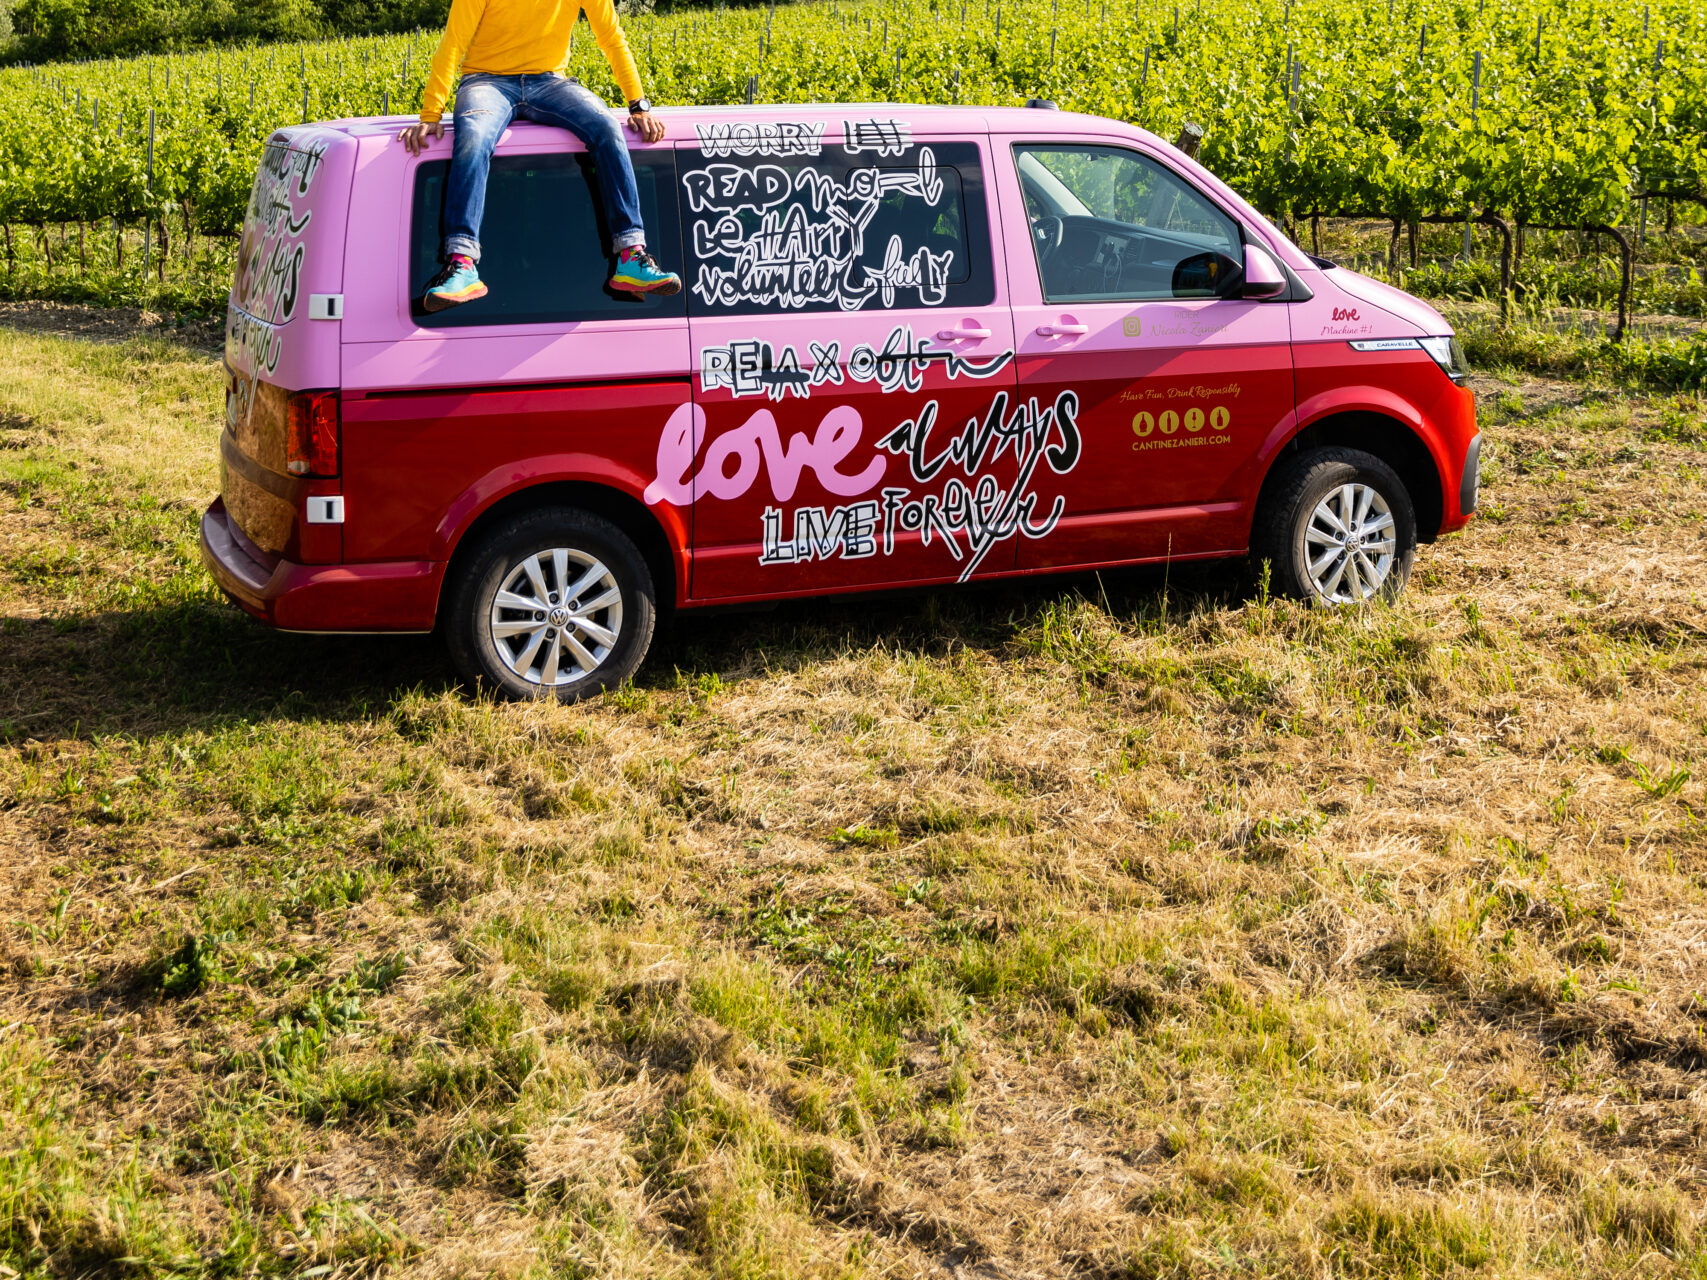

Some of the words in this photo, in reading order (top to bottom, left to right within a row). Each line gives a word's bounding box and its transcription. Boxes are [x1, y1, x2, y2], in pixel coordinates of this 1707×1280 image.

[693, 122, 827, 157] WORRY
[682, 164, 792, 220] READ
[1321, 324, 1358, 336] Machine
[1360, 324, 1373, 334] #1
[1332, 307, 1360, 322] love
[701, 337, 845, 403] RELAX
[1119, 390, 1144, 404] Have
[1167, 386, 1195, 399] Drink
[643, 402, 887, 506] love
[1132, 435, 1231, 451] CANTINEZANIERI.COM
[760, 501, 880, 566] LIVE
